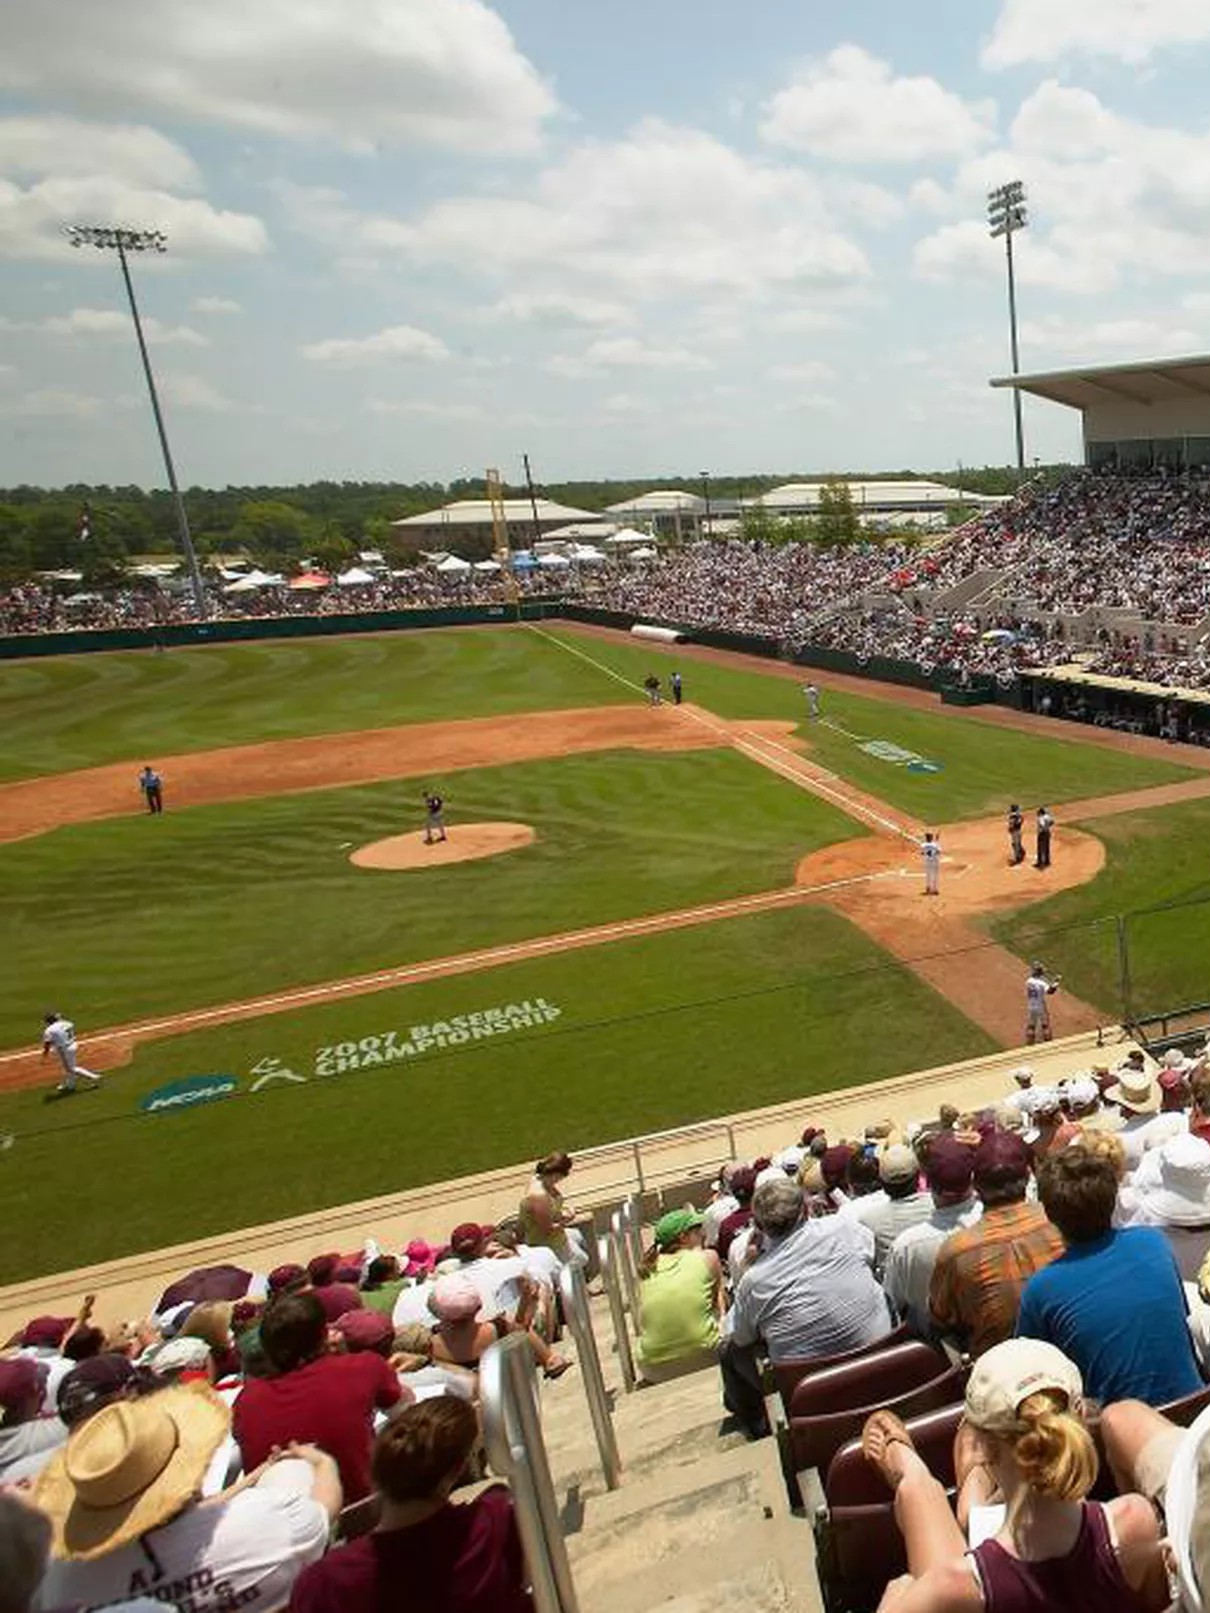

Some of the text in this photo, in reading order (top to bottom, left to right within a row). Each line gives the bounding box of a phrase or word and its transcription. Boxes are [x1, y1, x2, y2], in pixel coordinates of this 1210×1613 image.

[314, 1003, 562, 1076] CHAMPIONSHIP
[316, 998, 547, 1064] 2007 BASEBALL
